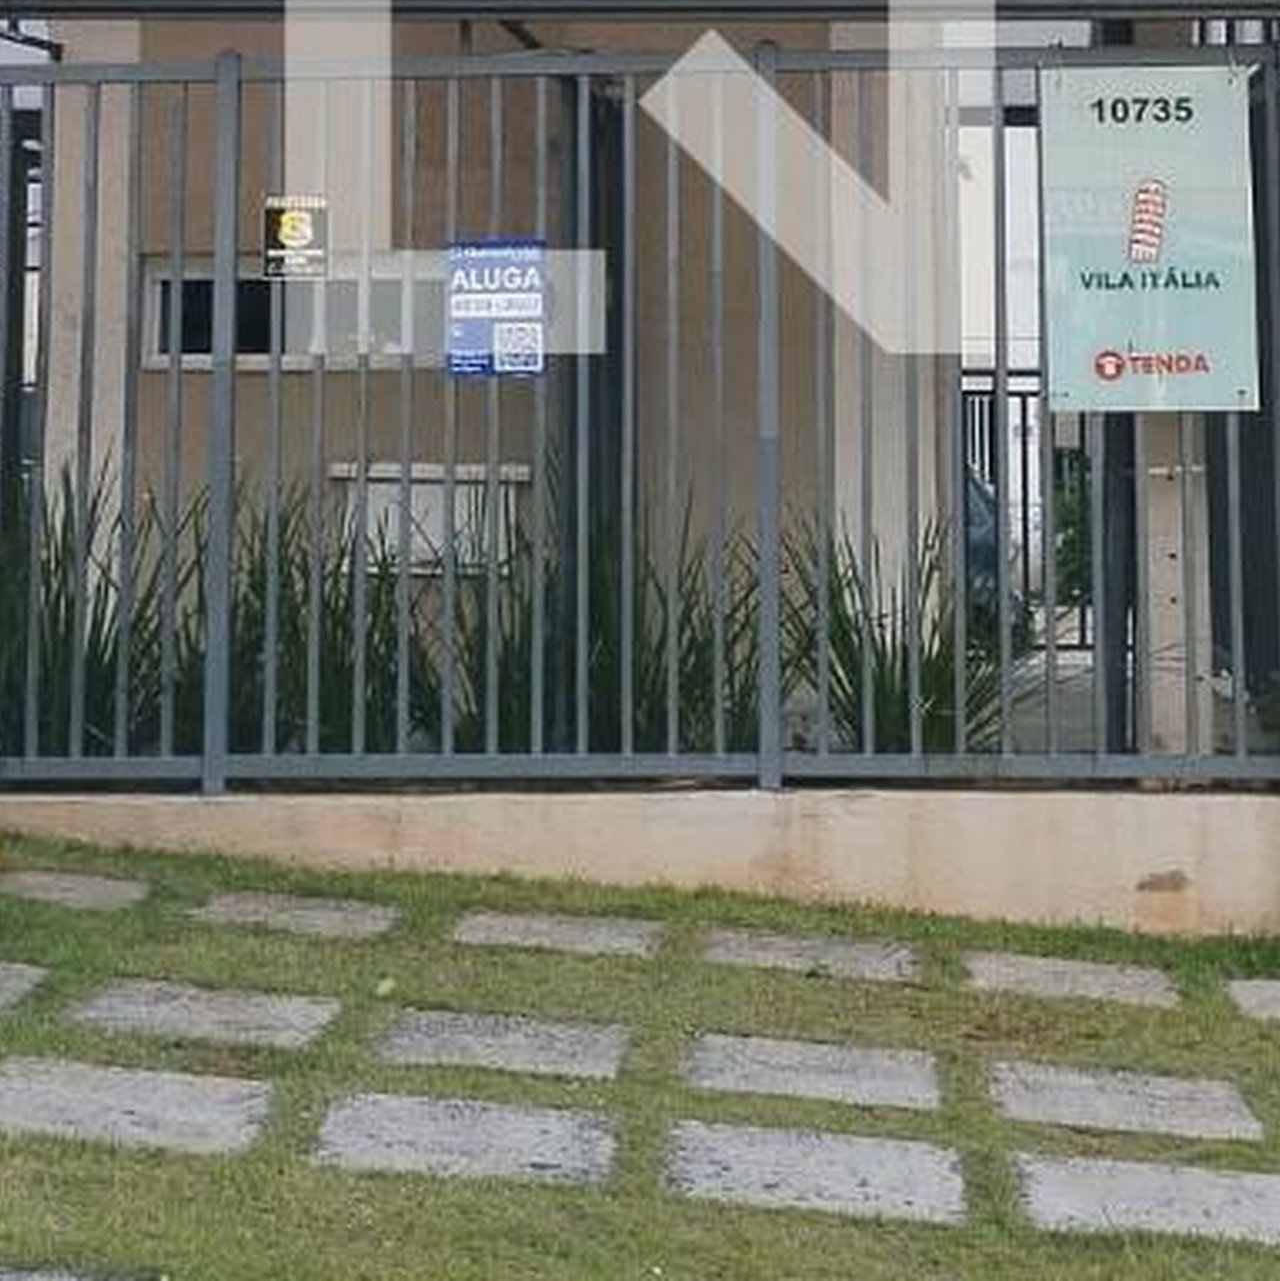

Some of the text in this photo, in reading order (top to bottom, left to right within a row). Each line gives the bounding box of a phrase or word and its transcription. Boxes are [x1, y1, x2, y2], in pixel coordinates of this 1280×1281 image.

[1090, 97, 1194, 123] 10735
[451, 266, 540, 290] ALUGA
[1081, 265, 1220, 290] VILA ITÁLIA
[1129, 354, 1209, 374] TENDA
